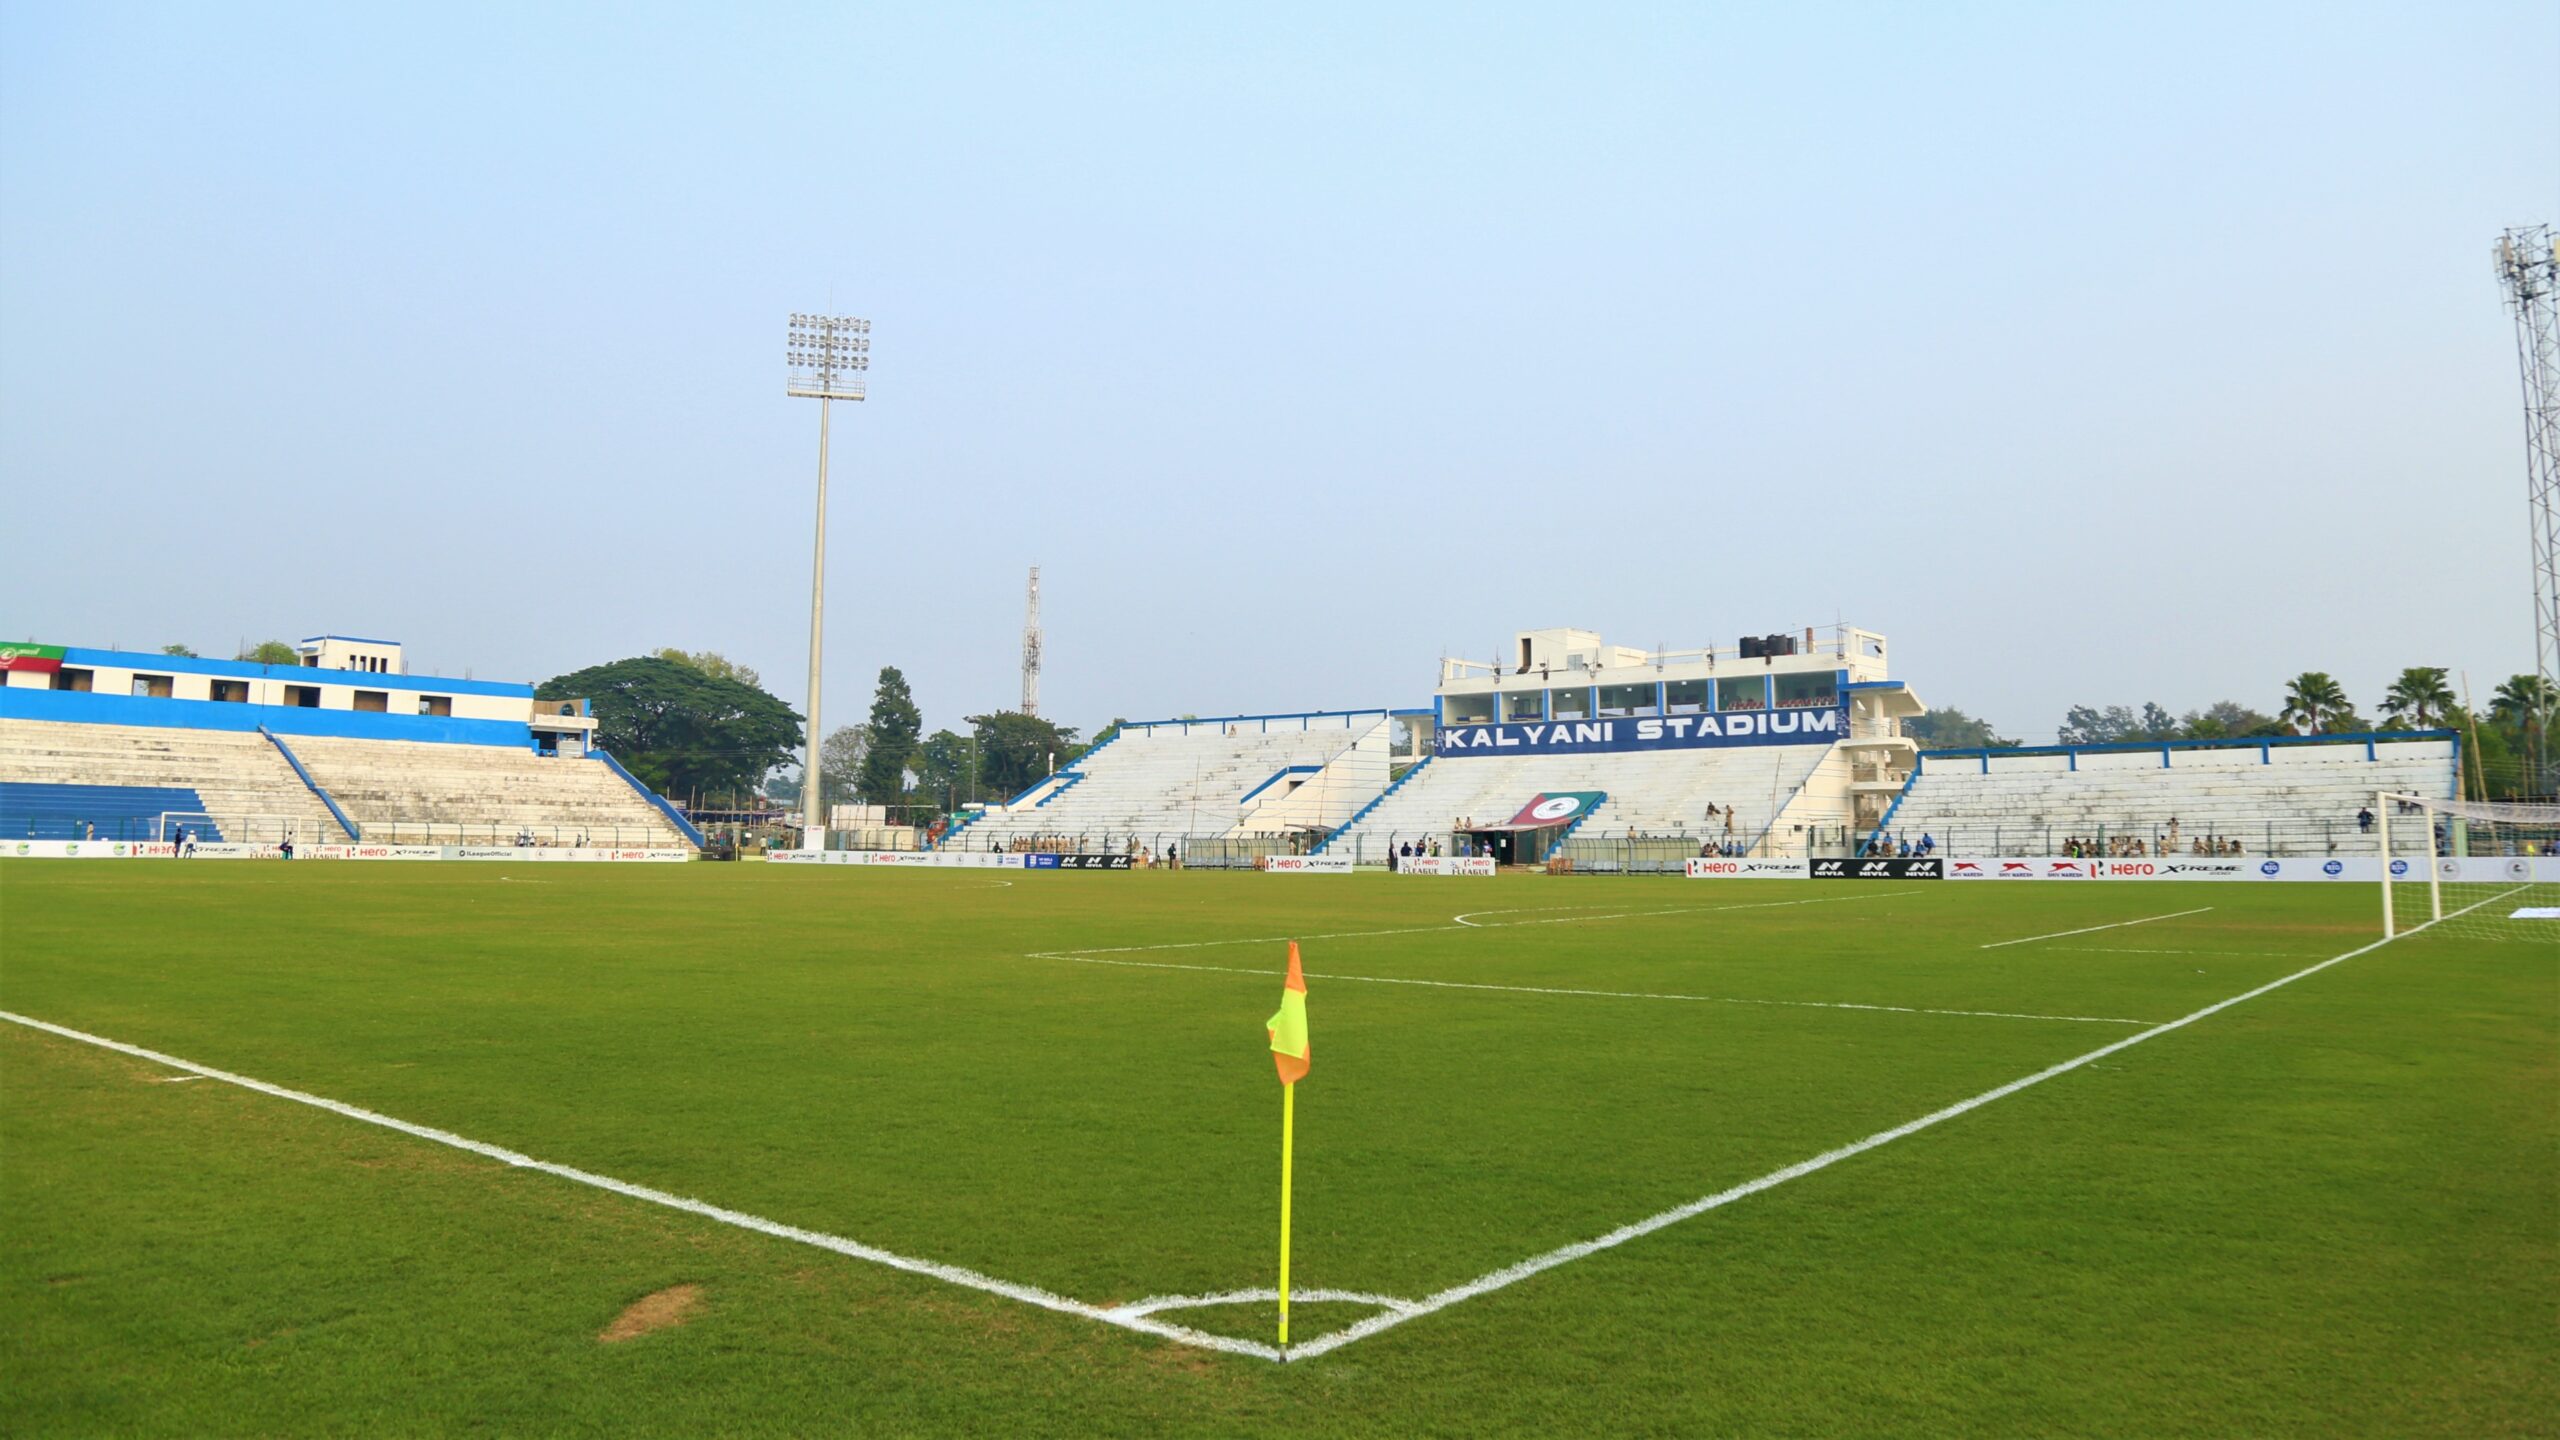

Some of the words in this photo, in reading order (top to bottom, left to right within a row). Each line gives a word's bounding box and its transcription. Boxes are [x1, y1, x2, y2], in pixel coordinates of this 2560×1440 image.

[1445, 722, 1613, 748] KALYANI
[1637, 710, 1836, 740] STADIUM
[360, 848, 387, 856] Hero
[1277, 859, 1302, 869] Hero
[1703, 862, 1738, 873] Hero
[2111, 863, 2155, 875] Hero
